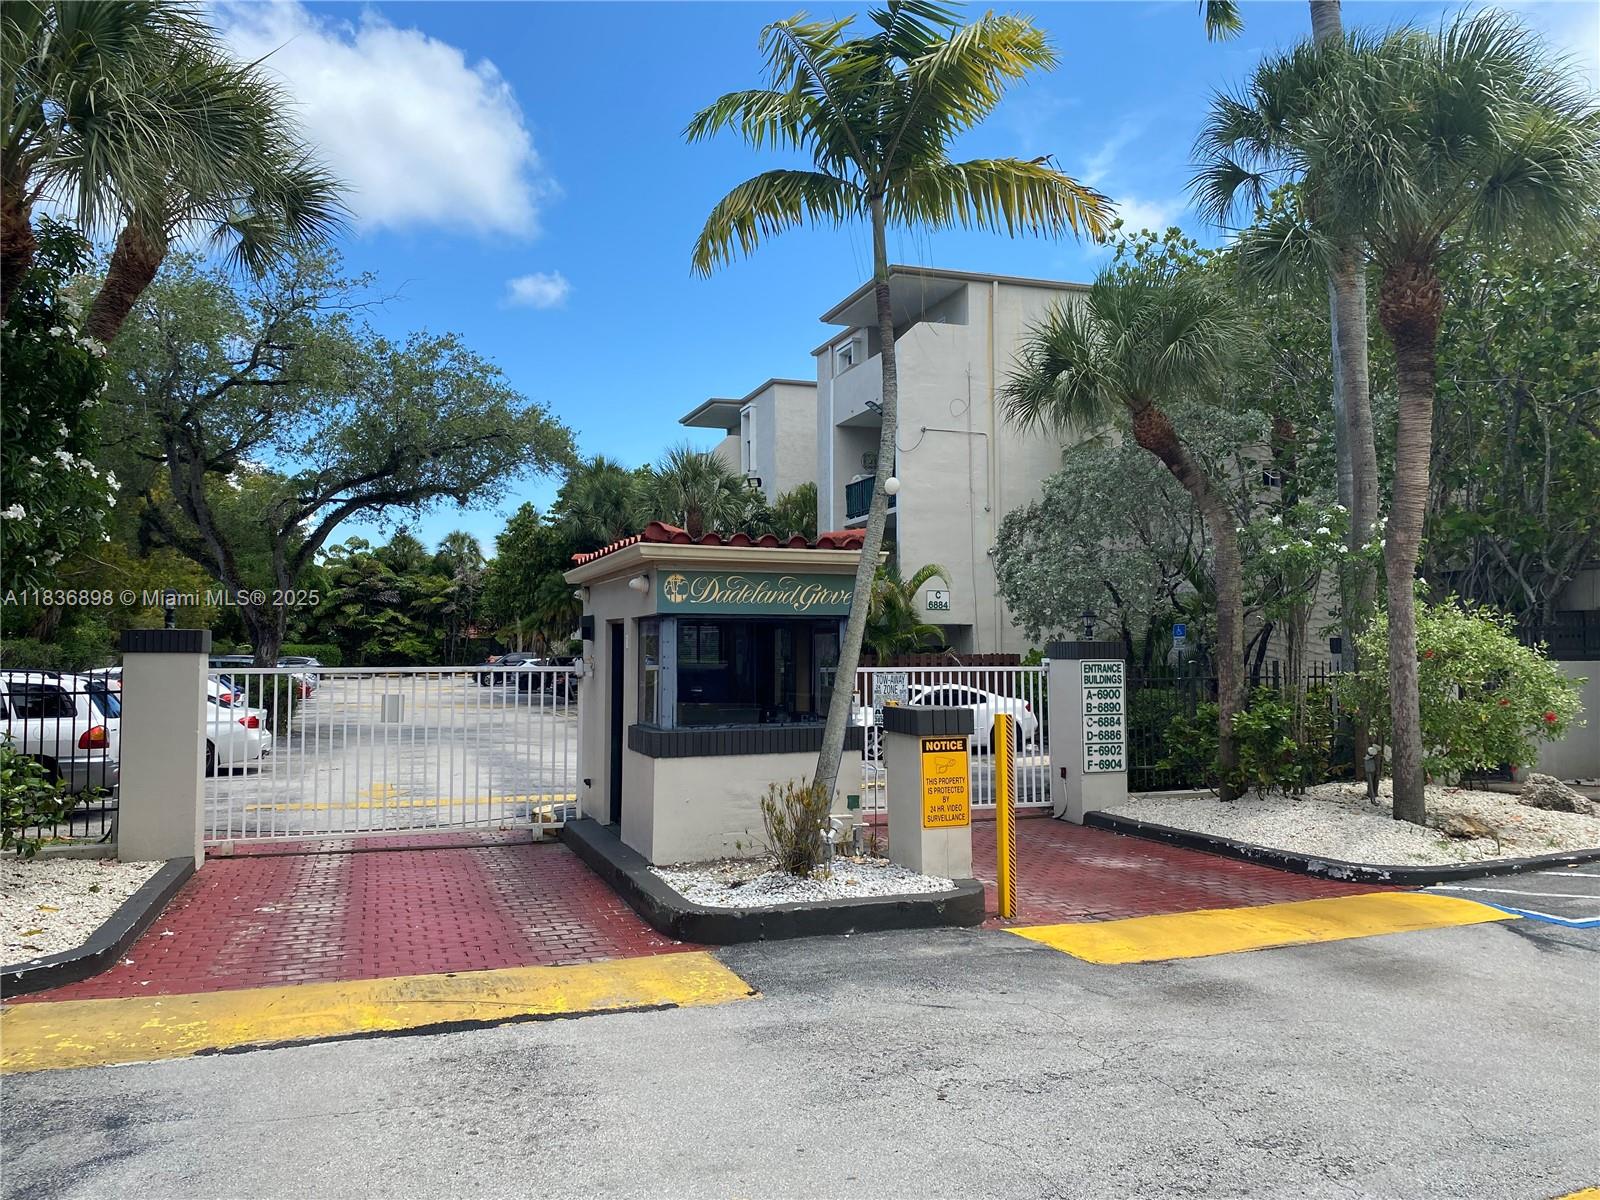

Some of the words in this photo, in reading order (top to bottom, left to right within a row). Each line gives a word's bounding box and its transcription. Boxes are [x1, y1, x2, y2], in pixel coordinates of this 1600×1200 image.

[690, 575, 808, 604] Dadeland
[793, 583, 853, 612] Grove
[935, 591, 941, 599] C
[928, 600, 948, 609] 6884
[1083, 664, 1121, 673] ENTRANCE
[876, 674, 905, 685] TOW-AWAY
[1083, 675, 1122, 684] BUILDINGS
[883, 685, 898, 695] ZONE
[1086, 689, 1121, 700] A-6900
[1086, 702, 1121, 713] B-6890
[1086, 717, 1121, 727] C-6884
[1087, 730, 1121, 740] D-6886
[926, 741, 963, 751] NOTICE
[1087, 745, 1122, 756] E-6902
[1087, 759, 1122, 770] F-6904
[926, 778, 937, 786] THIS
[939, 777, 965, 785] PROPERTY
[928, 787, 933, 795] IS
[934, 786, 964, 794] PROTECTED
[930, 805, 936, 813] 24
[947, 804, 962, 812] VIDEO
[927, 813, 965, 822] SURVEILLANCE
